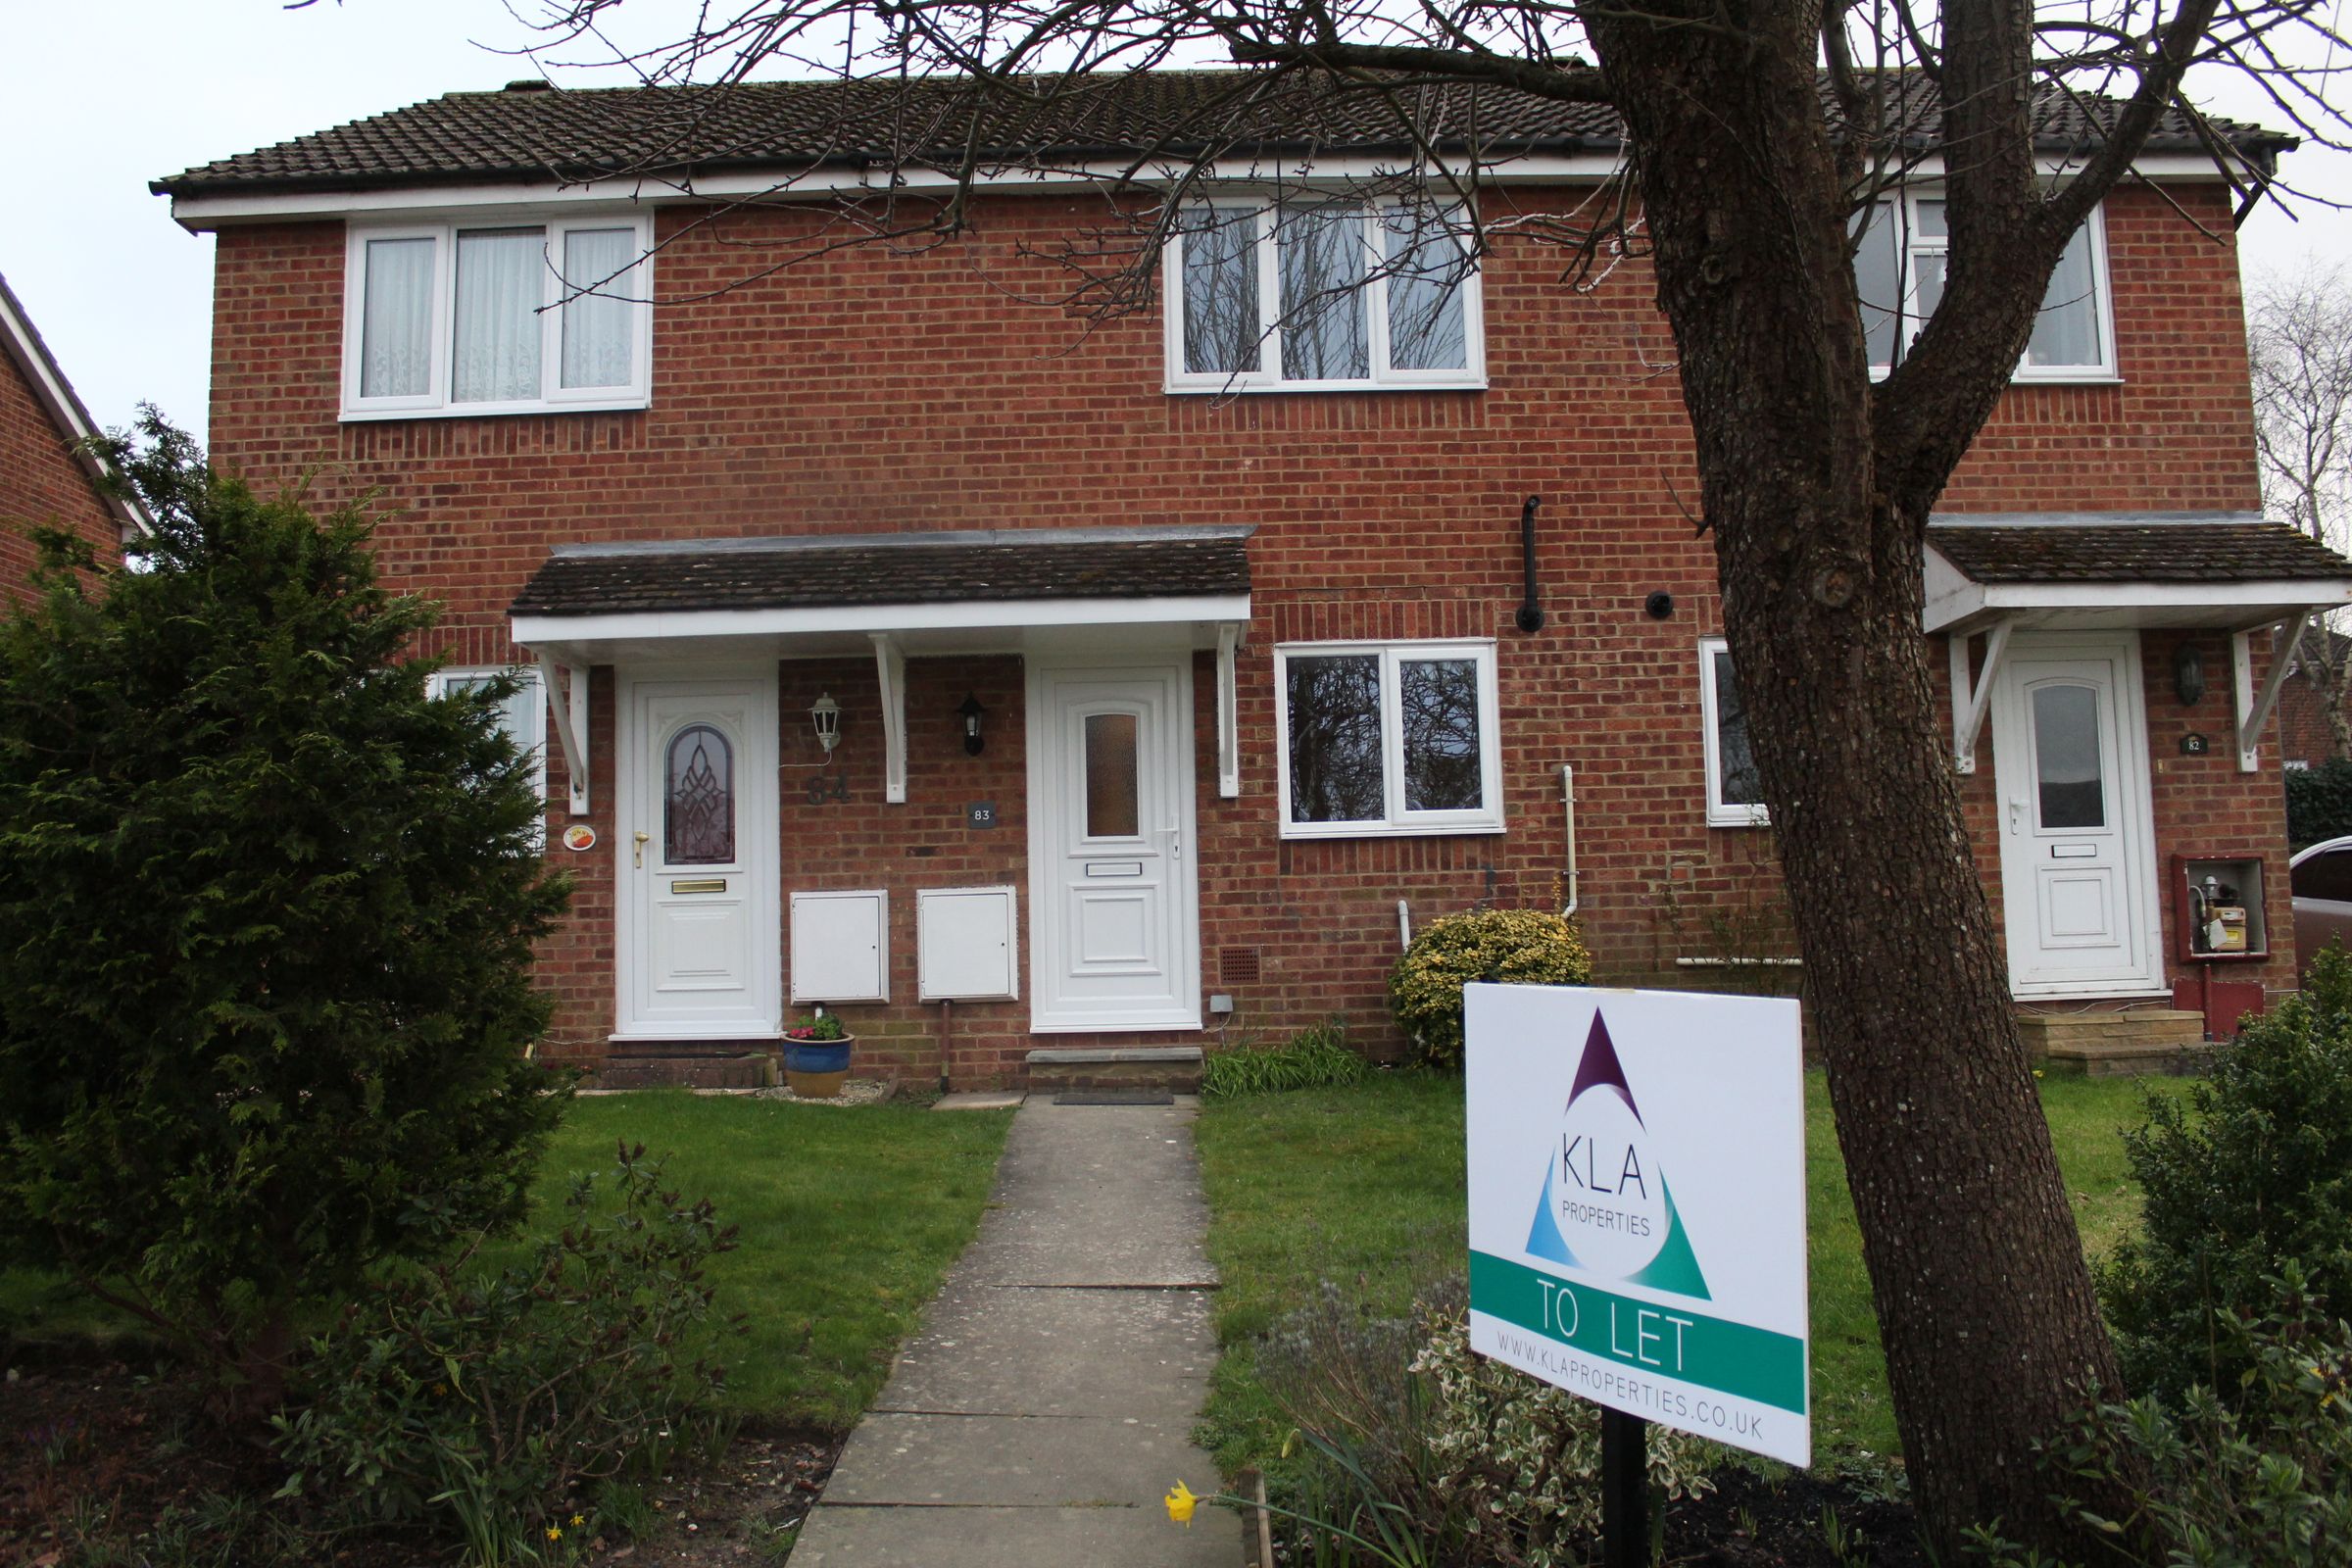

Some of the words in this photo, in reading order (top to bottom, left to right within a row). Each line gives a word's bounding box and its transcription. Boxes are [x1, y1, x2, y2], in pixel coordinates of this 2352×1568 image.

[2188, 740, 2200, 751] 82
[807, 772, 851, 806] 84
[974, 809, 990, 820] 83
[1563, 1132, 1647, 1200] KLA
[1562, 1200, 1650, 1237] PROPERTIES
[1537, 1278, 1579, 1338] TO
[1611, 1301, 1693, 1372] LET
[1496, 1330, 1764, 1441] WWW.KLAPROPERTIES.CO.UK
